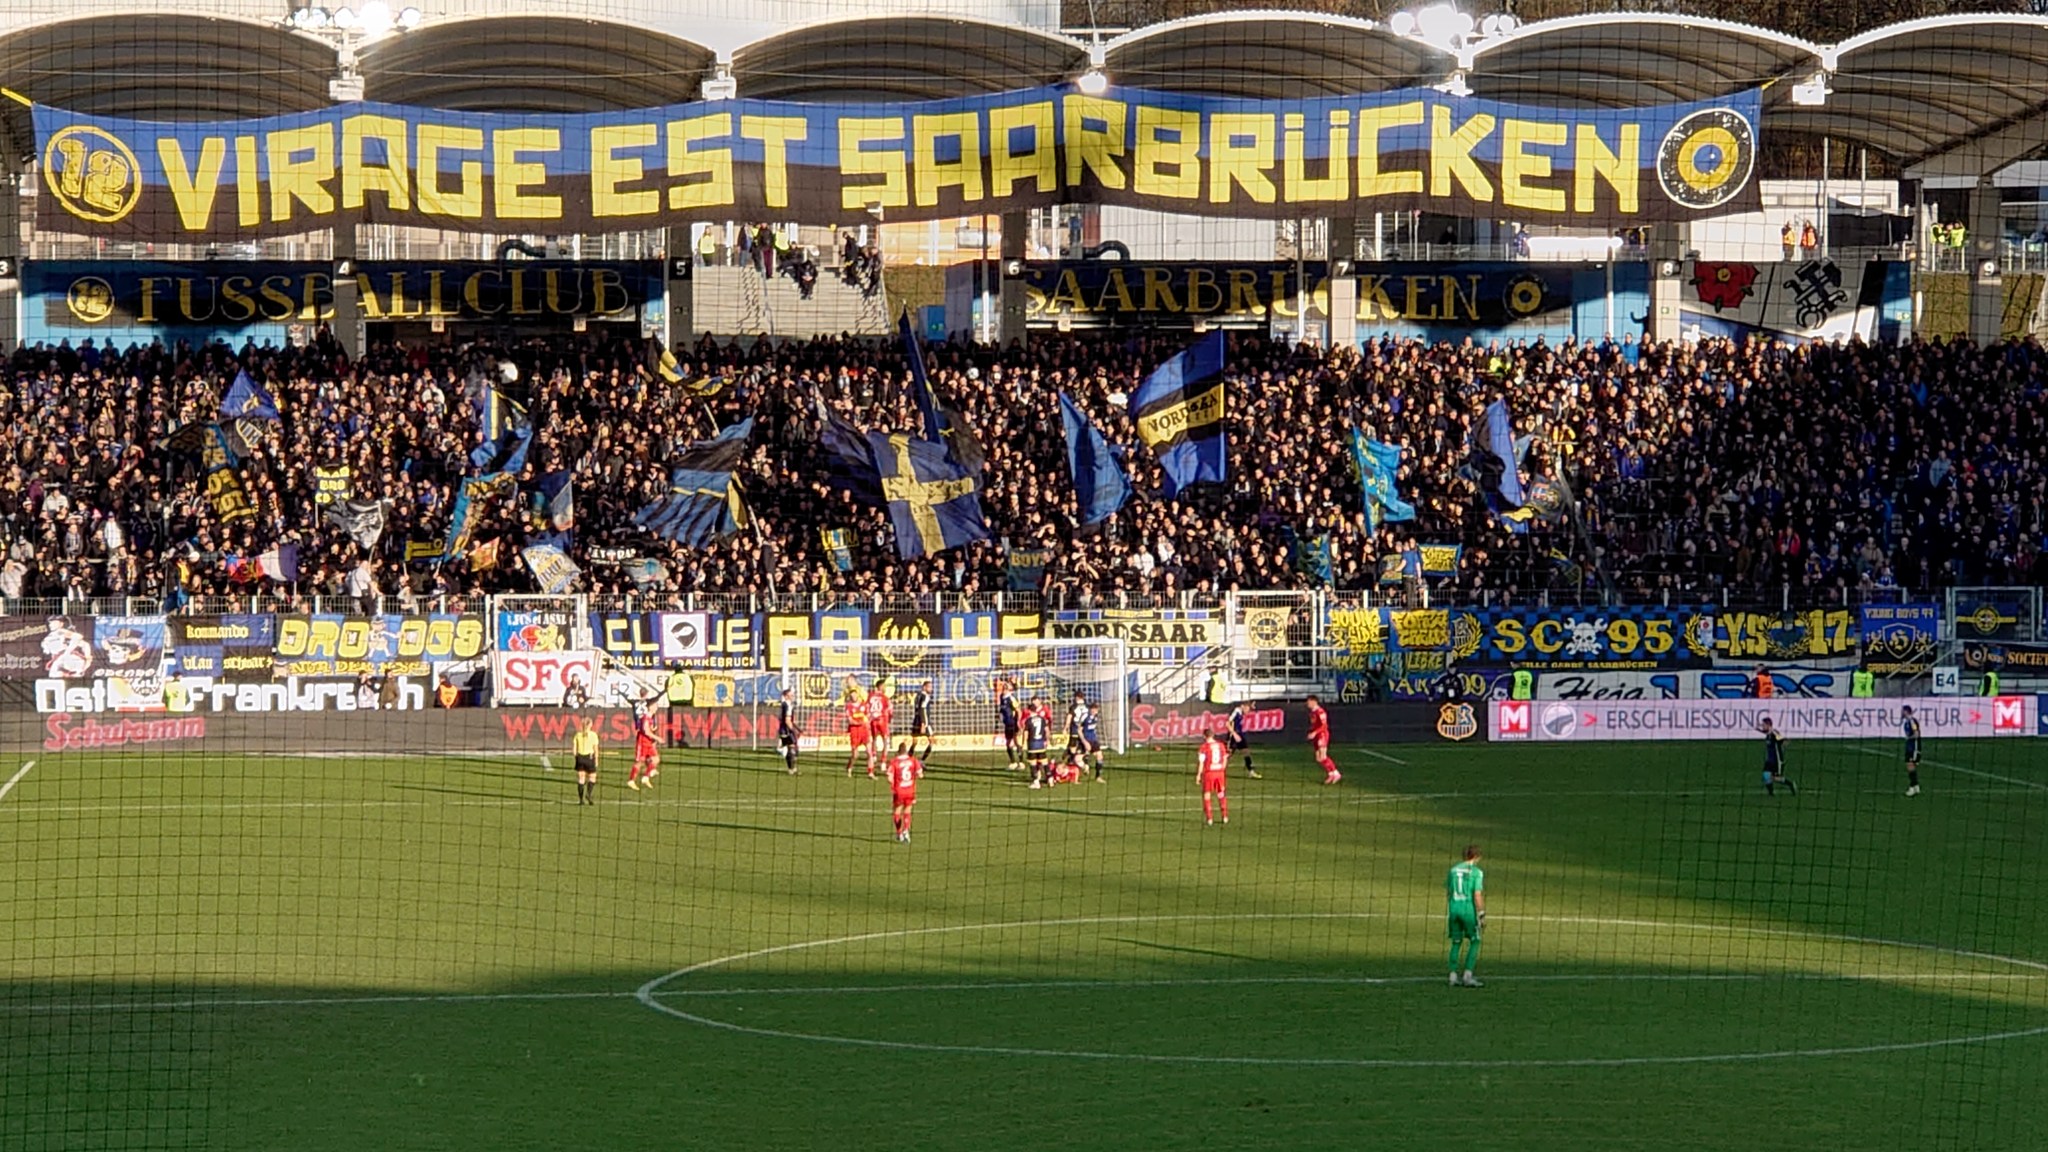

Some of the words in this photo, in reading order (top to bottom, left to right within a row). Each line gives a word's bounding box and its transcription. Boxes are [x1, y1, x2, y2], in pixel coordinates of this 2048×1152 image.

[157, 114, 563, 230] VIRAGE
[591, 113, 806, 217] EST
[839, 95, 1640, 213] SAARBRÜCKEN
[339, 262, 350, 275] 4
[675, 262, 685, 276] 5
[1008, 261, 1020, 275] 6
[1337, 261, 1349, 275] 7
[1662, 262, 1674, 275] 8
[1984, 261, 1995, 276] 9
[1052, 622, 1208, 642] NORDSAAR
[504, 657, 591, 691] SFC
[1936, 673, 1955, 686] E4
[1606, 708, 1770, 730] ERSCHLIESSUNG
[44, 712, 206, 750] Schwamm
